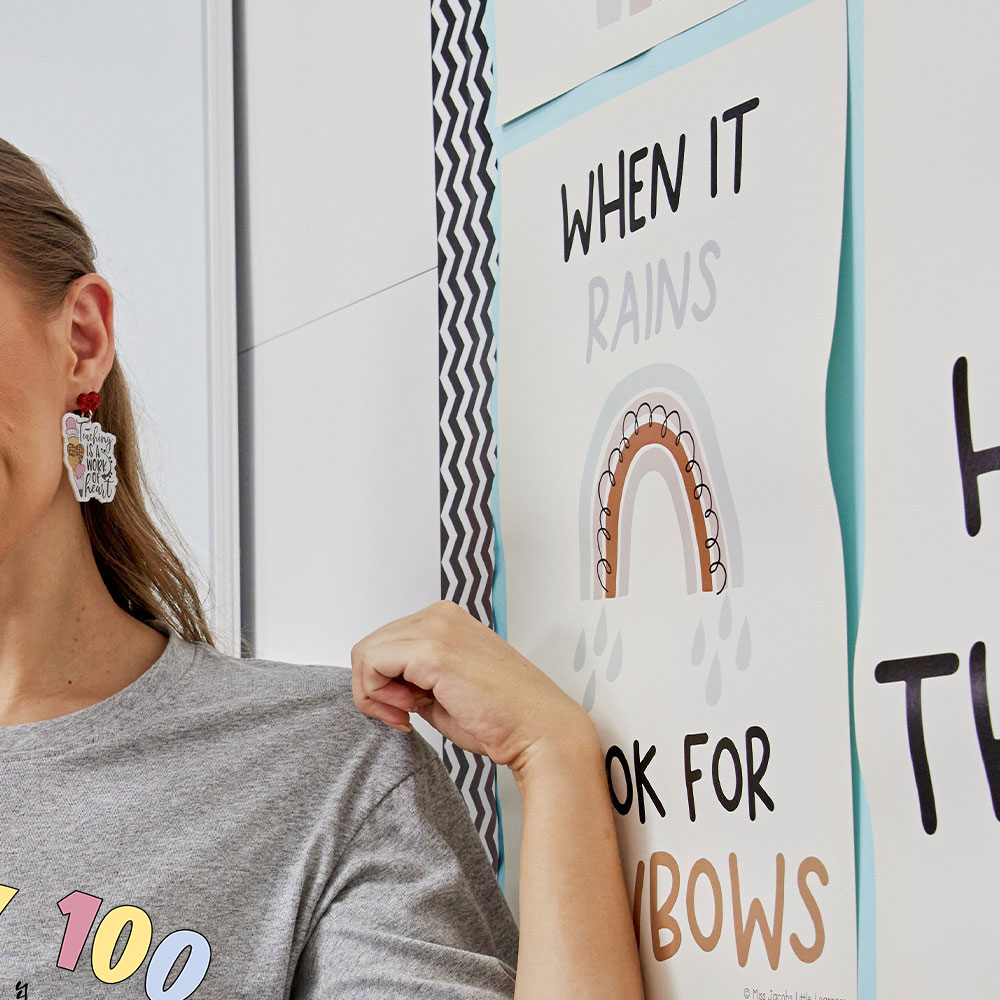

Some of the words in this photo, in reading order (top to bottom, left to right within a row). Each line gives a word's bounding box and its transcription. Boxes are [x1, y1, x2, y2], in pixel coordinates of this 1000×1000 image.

[560, 133, 686, 263] WHEN
[710, 97, 760, 198] IT
[585, 239, 722, 364] RAINS
[76, 418, 113, 453] Teaching
[86, 444, 93, 457] IS
[95, 444, 100, 457] A
[86, 459, 106, 472] WORK
[92, 471, 100, 484] OF
[85, 473, 114, 498] heart
[605, 739, 667, 824] OK
[683, 725, 775, 822] FOR
[633, 851, 829, 971] BOWS
[752, 989, 766, 1000] Miss
